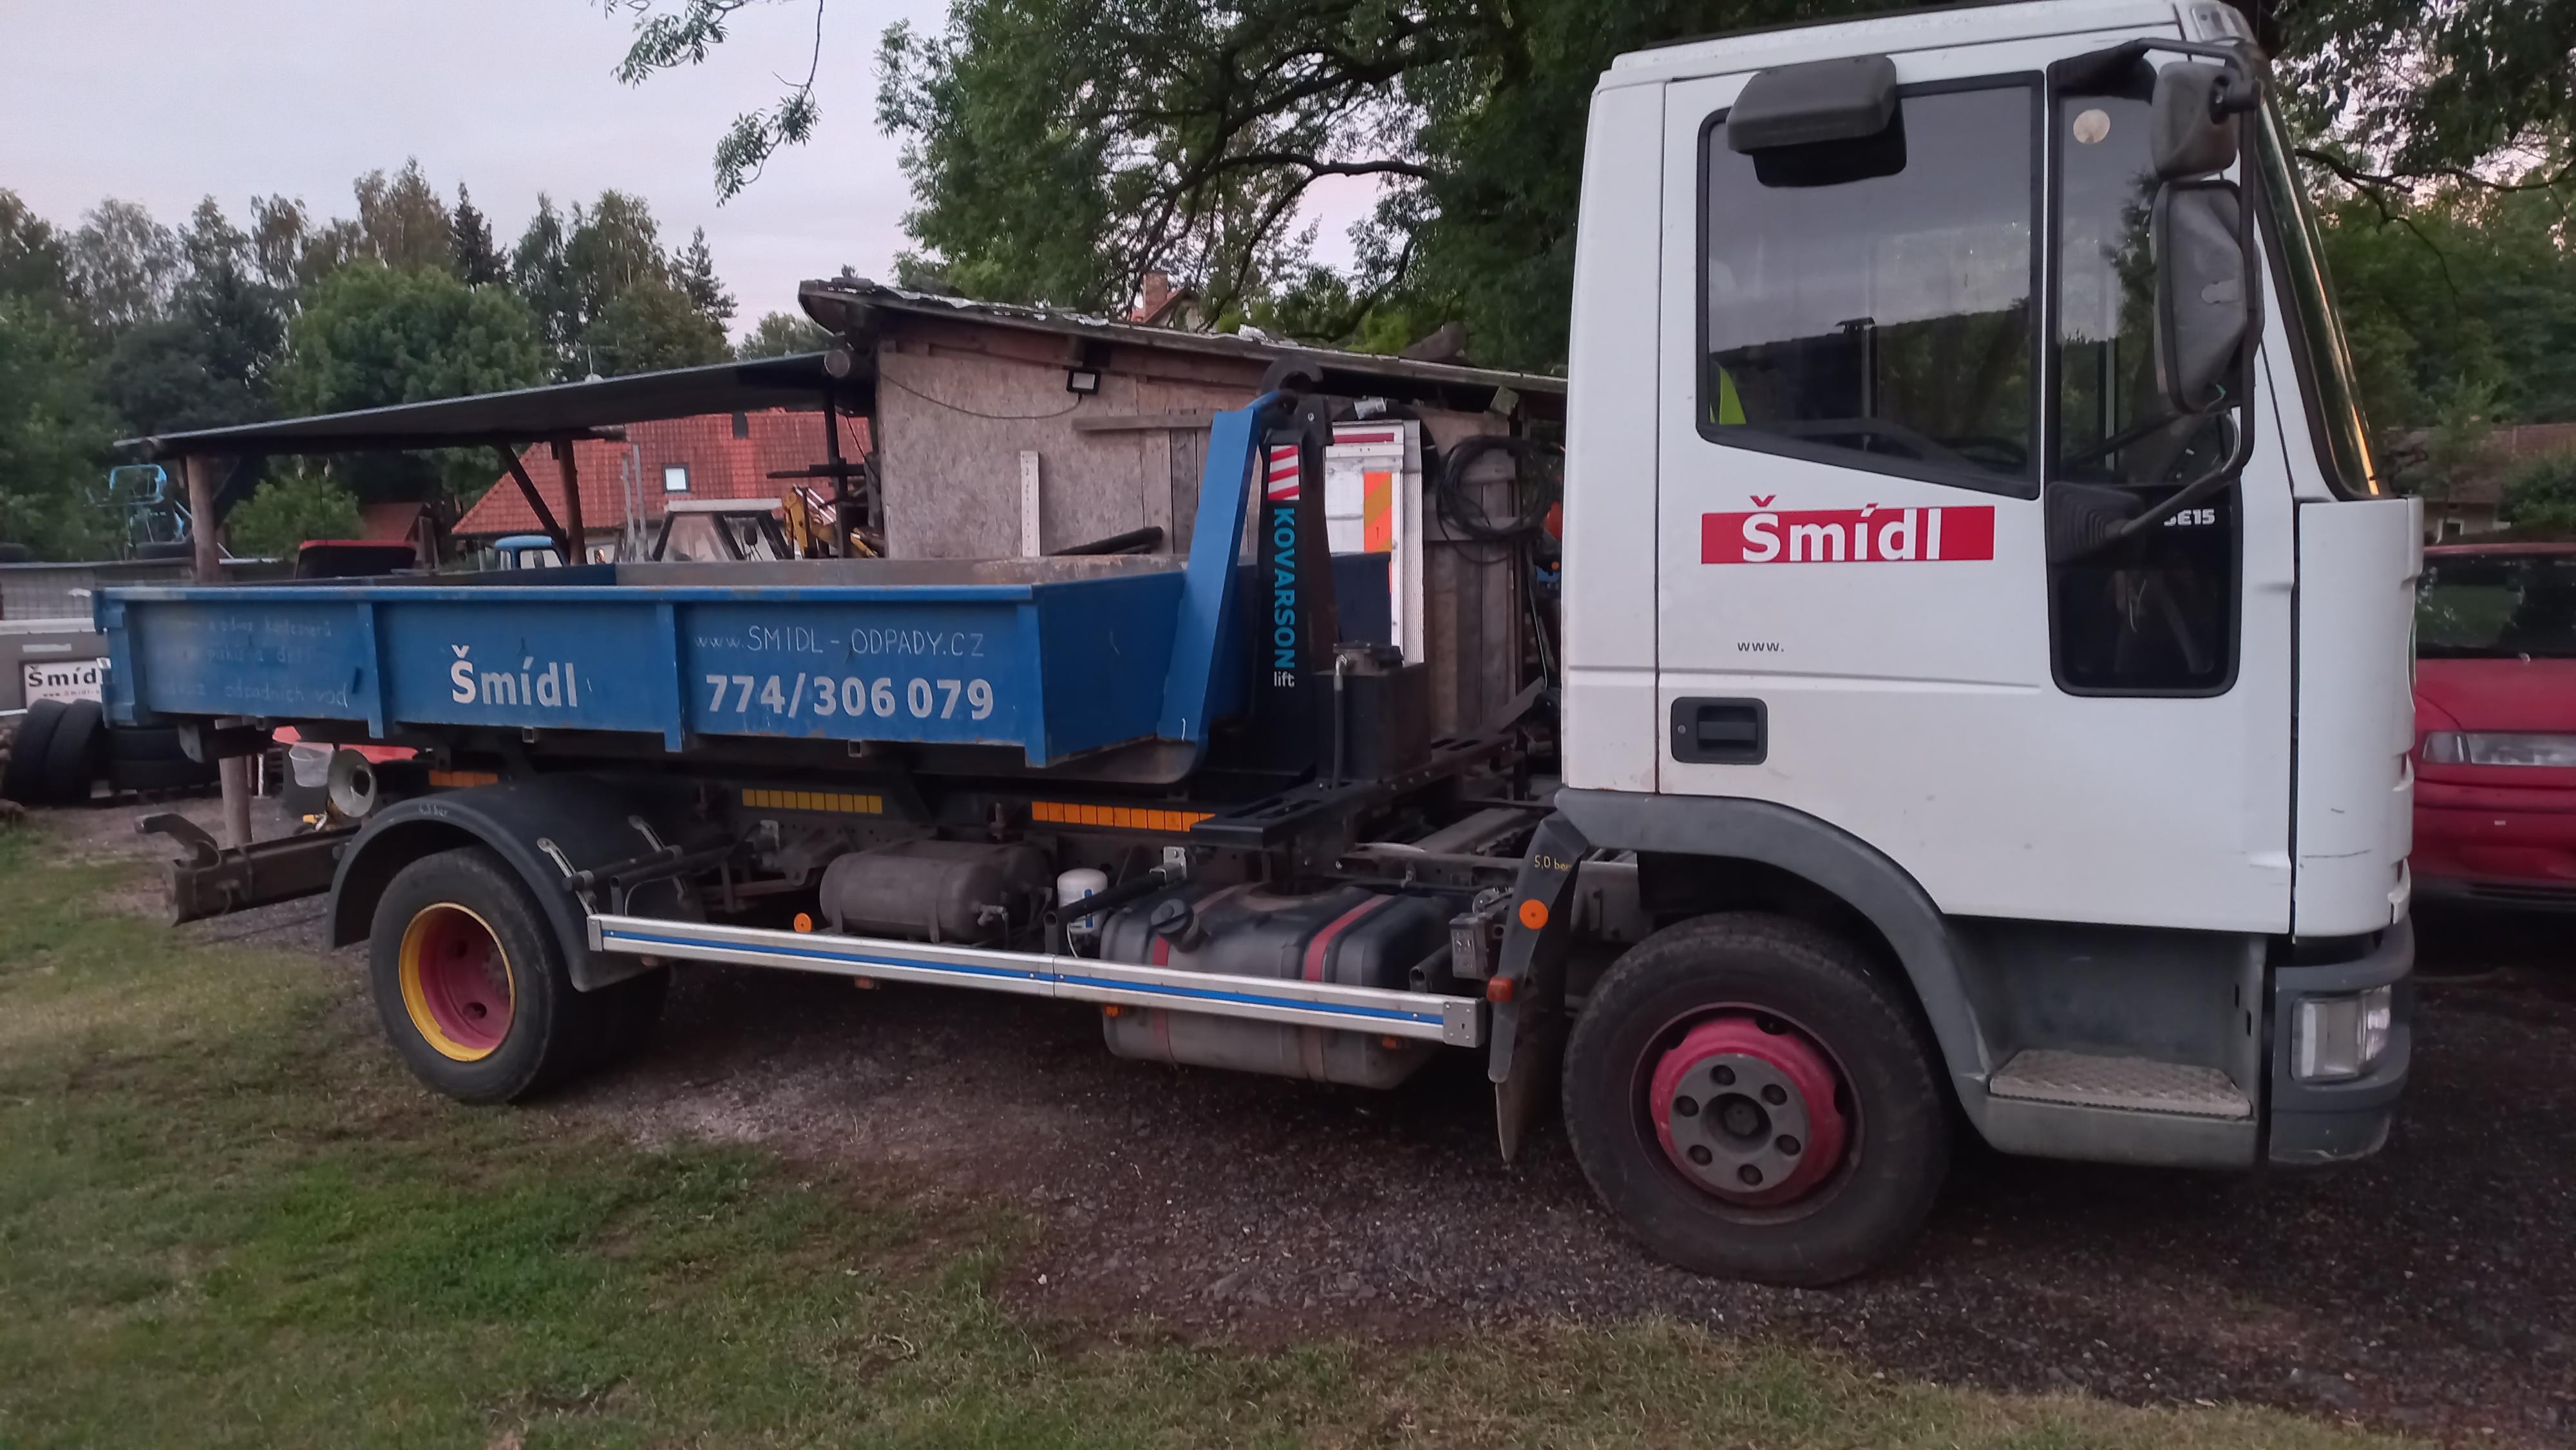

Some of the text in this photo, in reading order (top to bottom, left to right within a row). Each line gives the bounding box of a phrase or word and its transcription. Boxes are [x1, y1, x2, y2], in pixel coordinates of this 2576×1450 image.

[1742, 494, 1942, 563] Šmídl
[1274, 508, 1295, 668] KOVARSON
[1738, 643, 1784, 652] www.
[451, 645, 578, 707] Šmídl
[706, 672, 993, 720] 774/306 079
[1274, 671, 1295, 688] lift
[1534, 854, 1551, 871] 5,0
